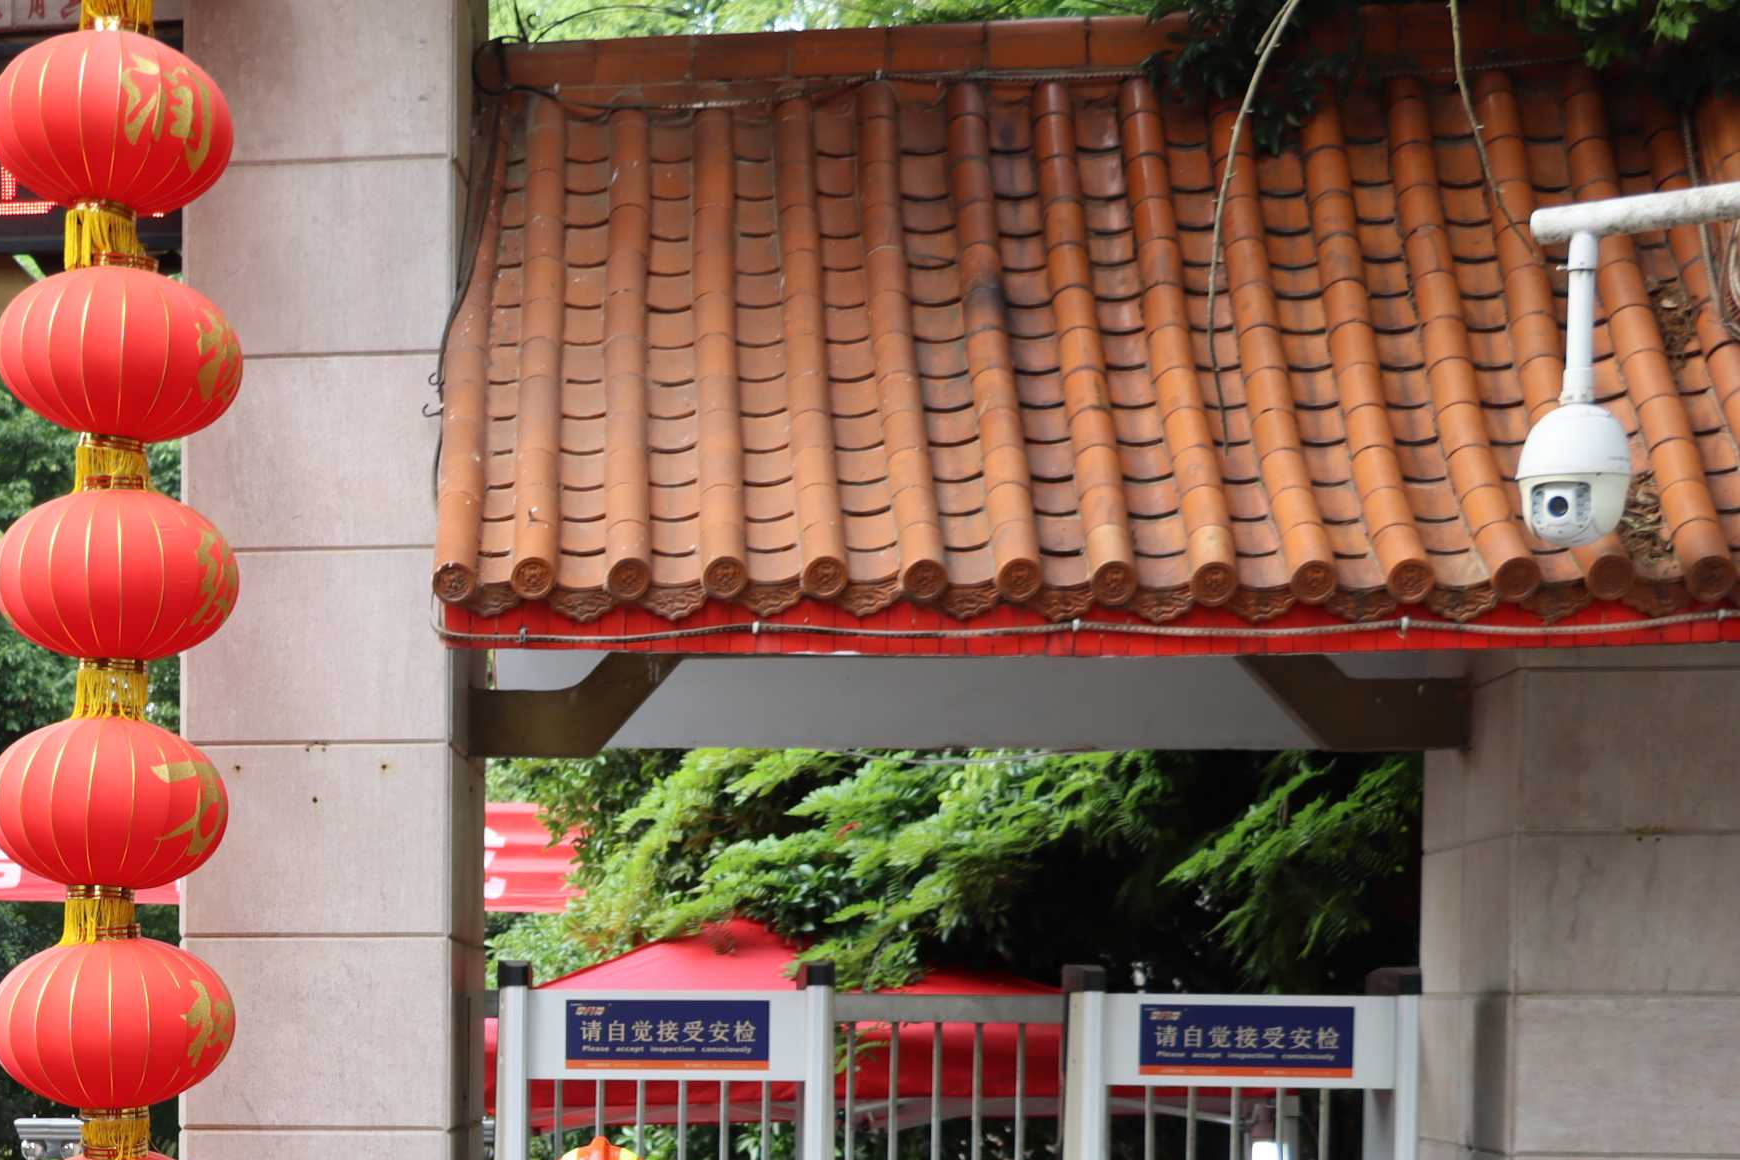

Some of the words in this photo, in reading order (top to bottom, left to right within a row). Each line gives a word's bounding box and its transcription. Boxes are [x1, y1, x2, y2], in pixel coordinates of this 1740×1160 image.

[579, 1019, 757, 1043] 请自觉接受安检
[1154, 1024, 1341, 1050] 请自觉接受安检
